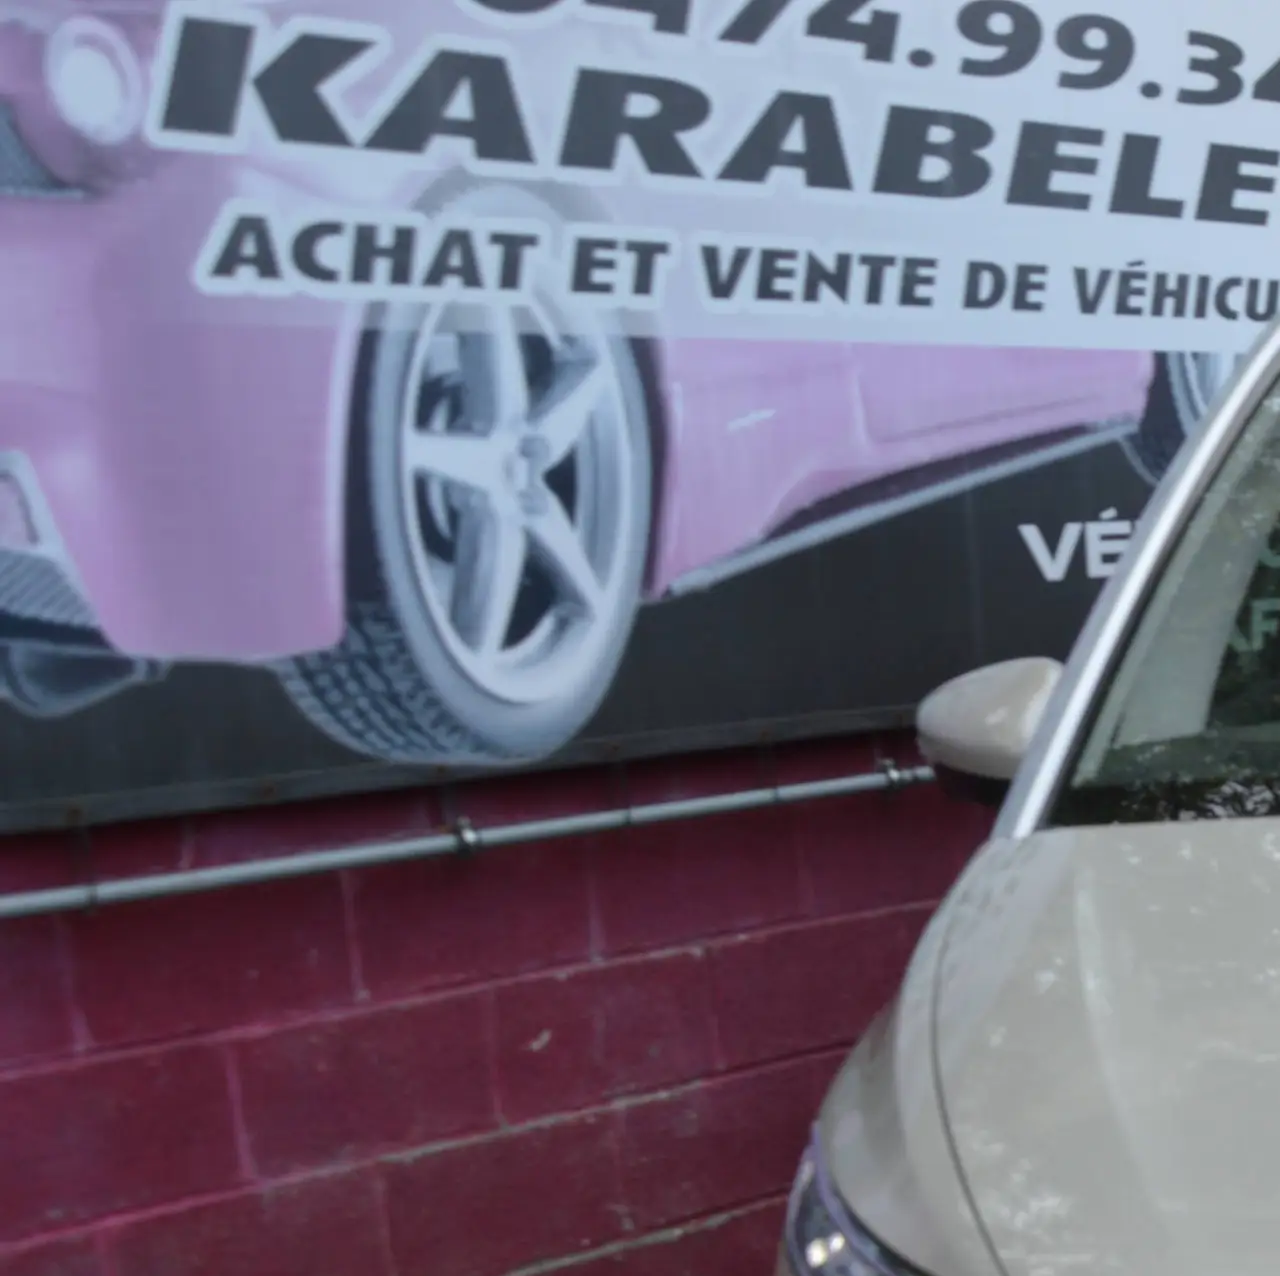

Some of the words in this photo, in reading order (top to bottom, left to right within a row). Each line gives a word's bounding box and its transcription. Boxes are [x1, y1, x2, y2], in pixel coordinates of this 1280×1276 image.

[210, 215, 538, 291] ACHAT
[569, 237, 669, 295] ET
[700, 245, 937, 309] VENTE
[963, 260, 1049, 312] DE
